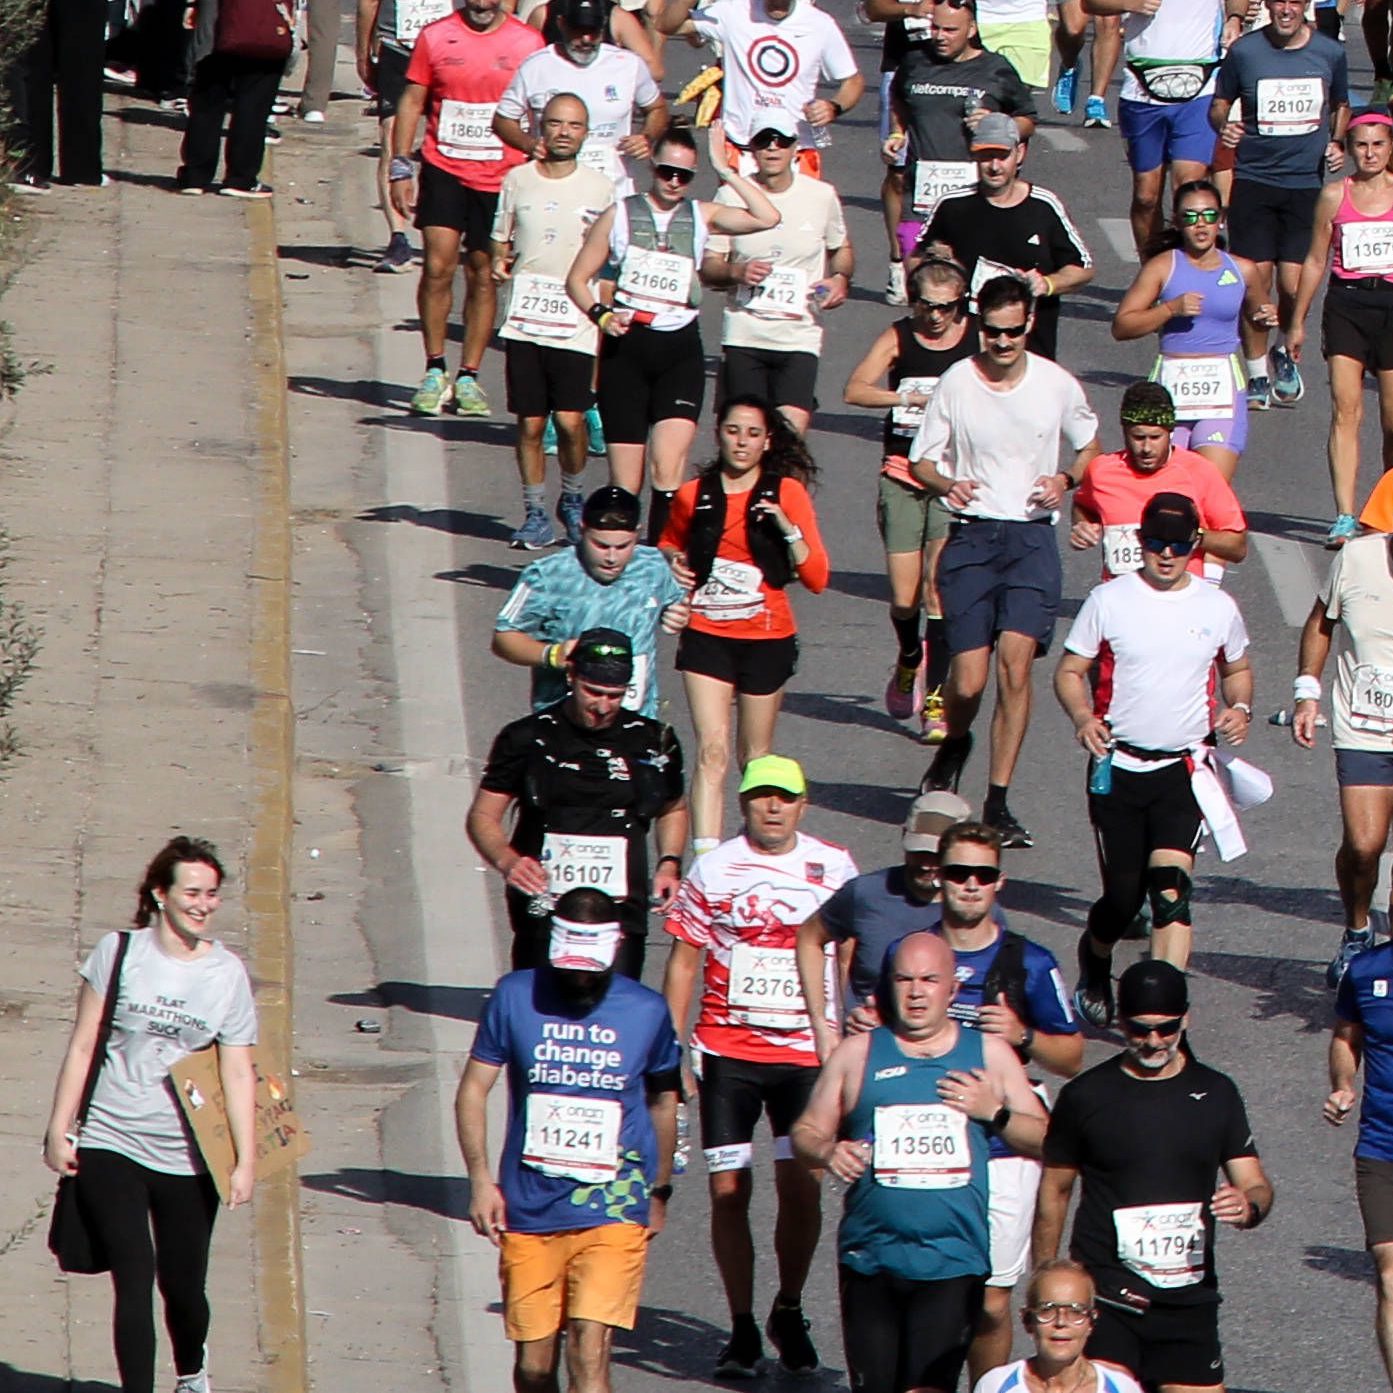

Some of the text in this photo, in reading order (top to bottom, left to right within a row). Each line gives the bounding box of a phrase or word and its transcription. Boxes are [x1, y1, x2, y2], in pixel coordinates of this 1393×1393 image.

[910, 83, 986, 100] Netcompany
[1267, 99, 1313, 114] 28107
[450, 122, 493, 139] 18605
[630, 270, 679, 292] 21606
[520, 295, 569, 315] 27396
[747, 286, 796, 304] 17412
[1172, 381, 1221, 397] 16597
[1112, 547, 1144, 564] 185
[553, 863, 613, 885] 16107
[742, 975, 805, 999] 23762
[155, 994, 186, 1009] FLAT
[128, 1002, 208, 1032] MARATHONS
[146, 1019, 183, 1037] SUCK
[543, 1022, 617, 1045] run to
[533, 1040, 622, 1070] change
[528, 1061, 624, 1091] diabetes
[539, 1126, 604, 1152] 11241
[891, 1135, 956, 1156] 13560
[1134, 1234, 1196, 1257] 11794
